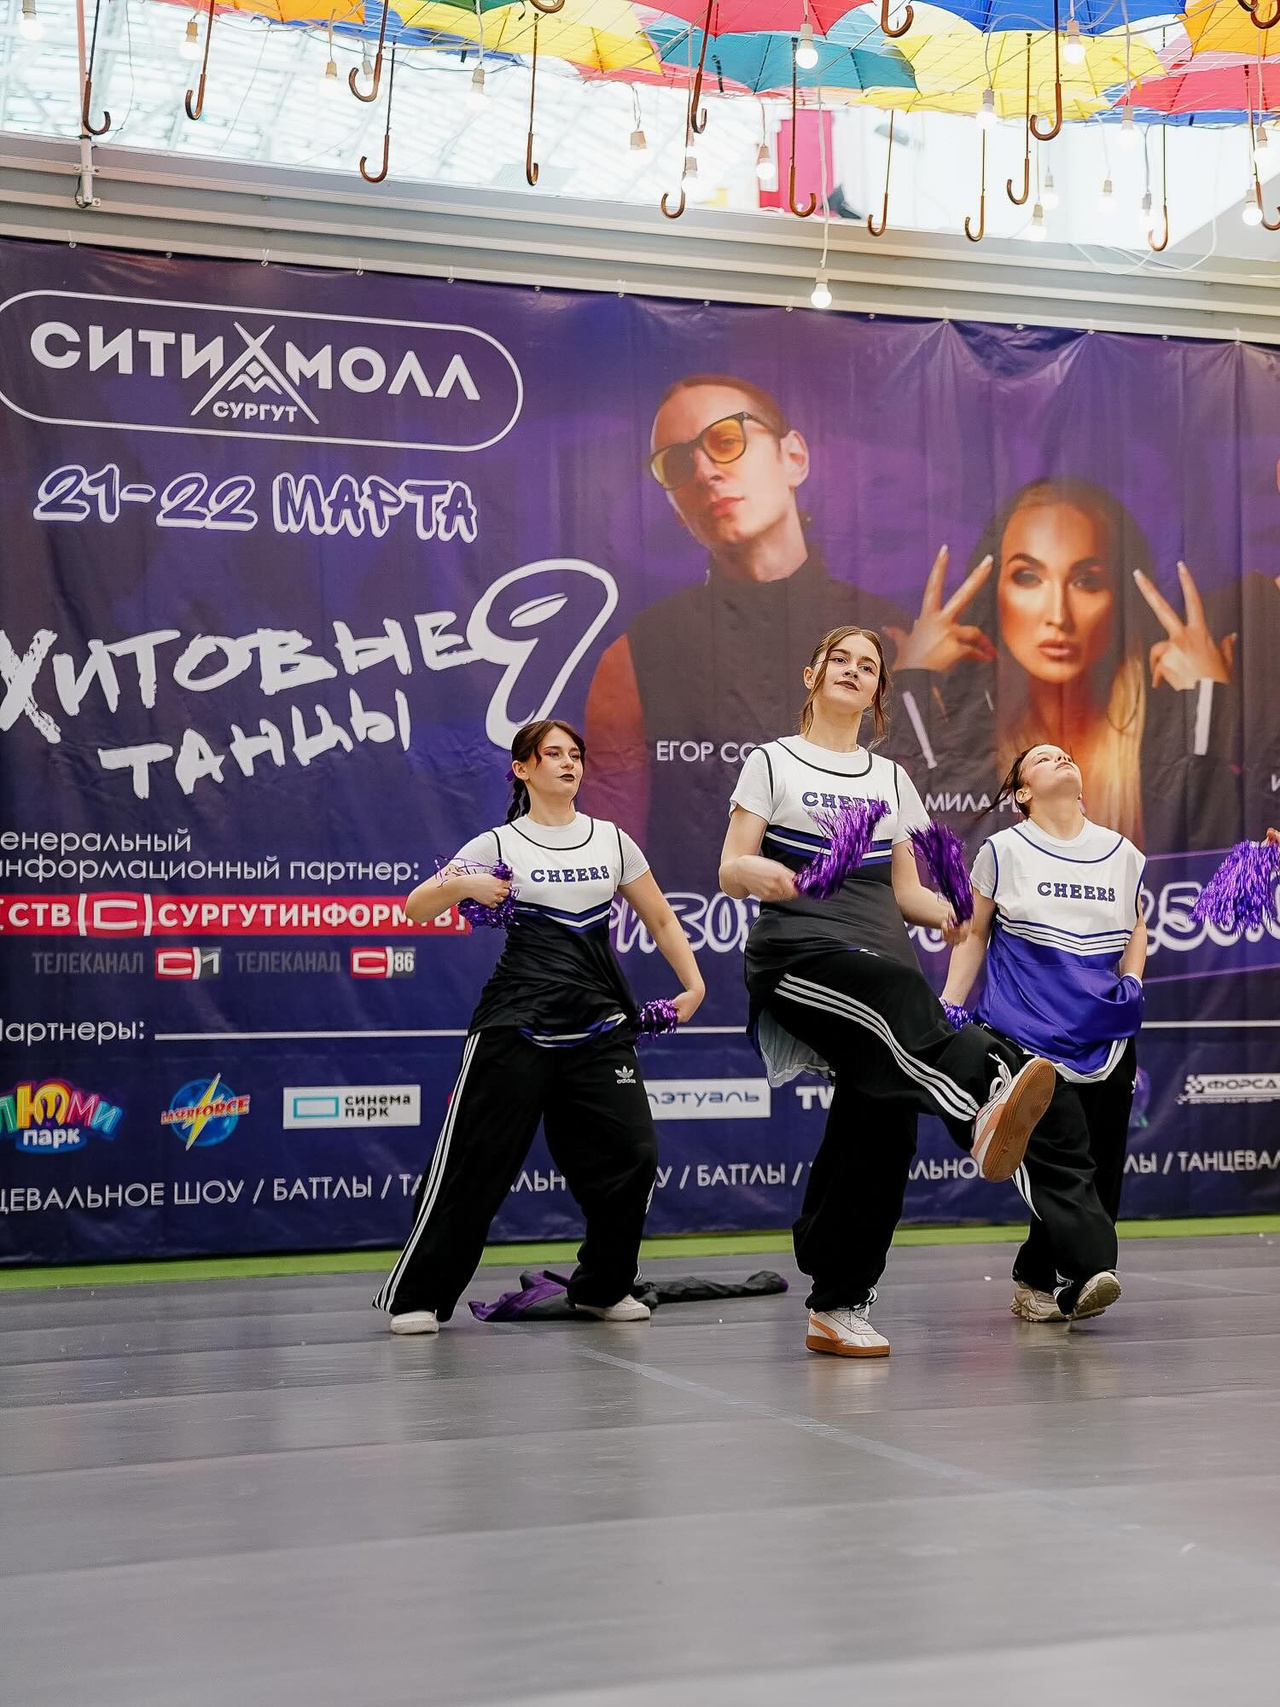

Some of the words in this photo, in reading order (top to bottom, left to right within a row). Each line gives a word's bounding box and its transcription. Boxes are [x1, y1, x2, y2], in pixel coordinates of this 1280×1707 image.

[30, 321, 225, 380] СИТИ
[286, 344, 481, 401] МОЛЛ
[212, 400, 299, 423] СУРГУТ
[33, 464, 259, 531] 21-22
[271, 472, 479, 544] МАРТА
[98, 688, 411, 799] ТАНЦЫ
[656, 740, 714, 762] ЕГОР
[0, 827, 192, 856] енеральный
[289, 861, 420, 886] партнер:
[531, 865, 610, 883] CHEERS
[1037, 881, 1116, 902] CHEERS
[32, 951, 145, 975] ТЕЛЕКАНАЛ
[235, 951, 342, 974] ТЕЛЕКАНАЛ
[345, 1093, 412, 1106] синема
[345, 1106, 390, 1121] парк
[23, 1127, 80, 1150] парк
[173, 1179, 245, 1206] ШОУ
[273, 1175, 372, 1202] БАТТЛЫ
[697, 1163, 786, 1187] БАТТЛЫ
